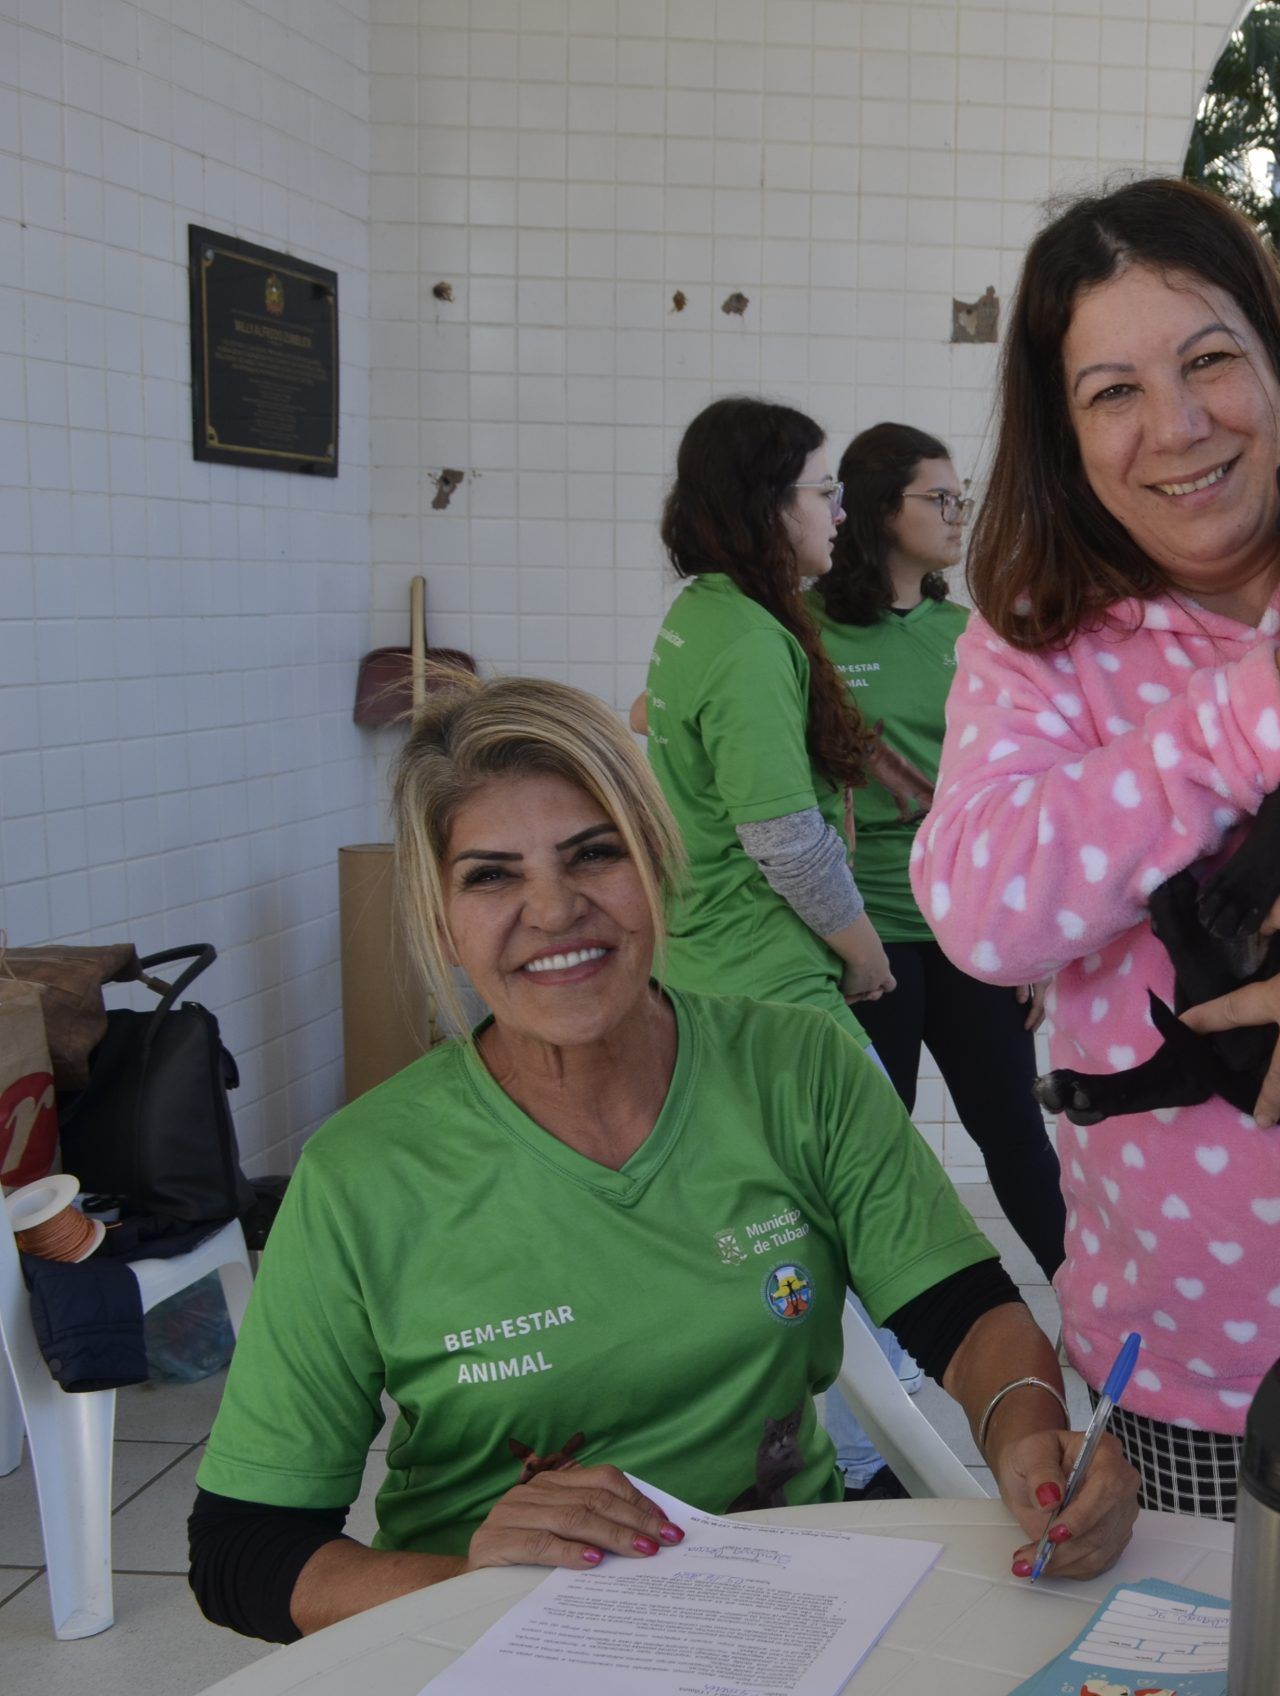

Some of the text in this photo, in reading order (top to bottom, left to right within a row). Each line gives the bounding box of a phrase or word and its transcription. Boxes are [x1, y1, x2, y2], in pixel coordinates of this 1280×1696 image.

[846, 678, 870, 688] MAL
[753, 1238, 772, 1255] de
[443, 1305, 576, 1353] BEM-ESTAR
[457, 1351, 553, 1384] ANIMAL
